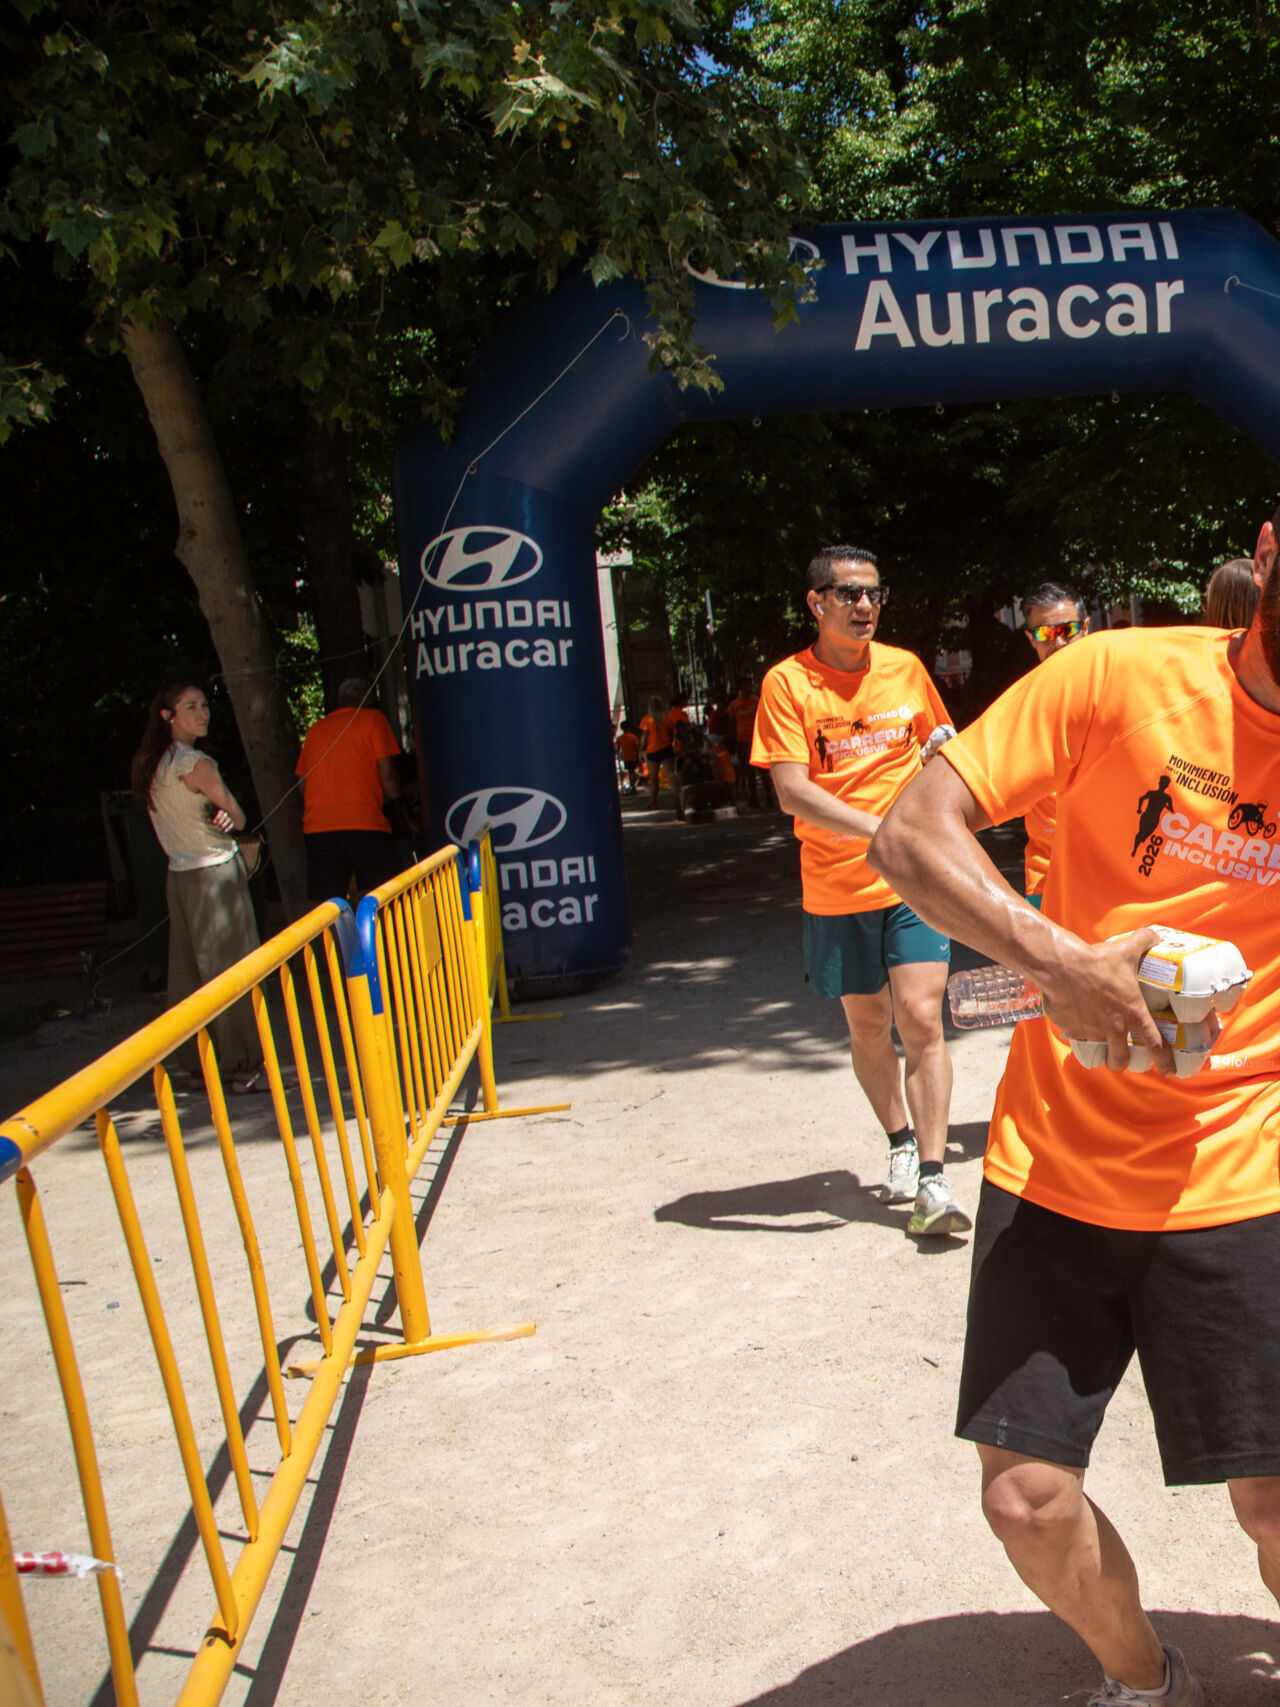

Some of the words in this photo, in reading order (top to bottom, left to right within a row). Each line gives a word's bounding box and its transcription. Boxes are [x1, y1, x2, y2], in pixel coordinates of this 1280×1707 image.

[841, 221, 1180, 275] HYUNDAI
[854, 279, 1185, 351] Auracar
[410, 600, 572, 640] HYUNDAI
[416, 638, 573, 679] Auracar
[826, 726, 908, 752] CARRERA
[1168, 754, 1231, 787] MOVIMIENTO
[1175, 772, 1239, 805] INCLUSIÓN
[500, 855, 597, 891] NDAI
[1138, 834, 1163, 877] 2026
[502, 894, 599, 931] acar
